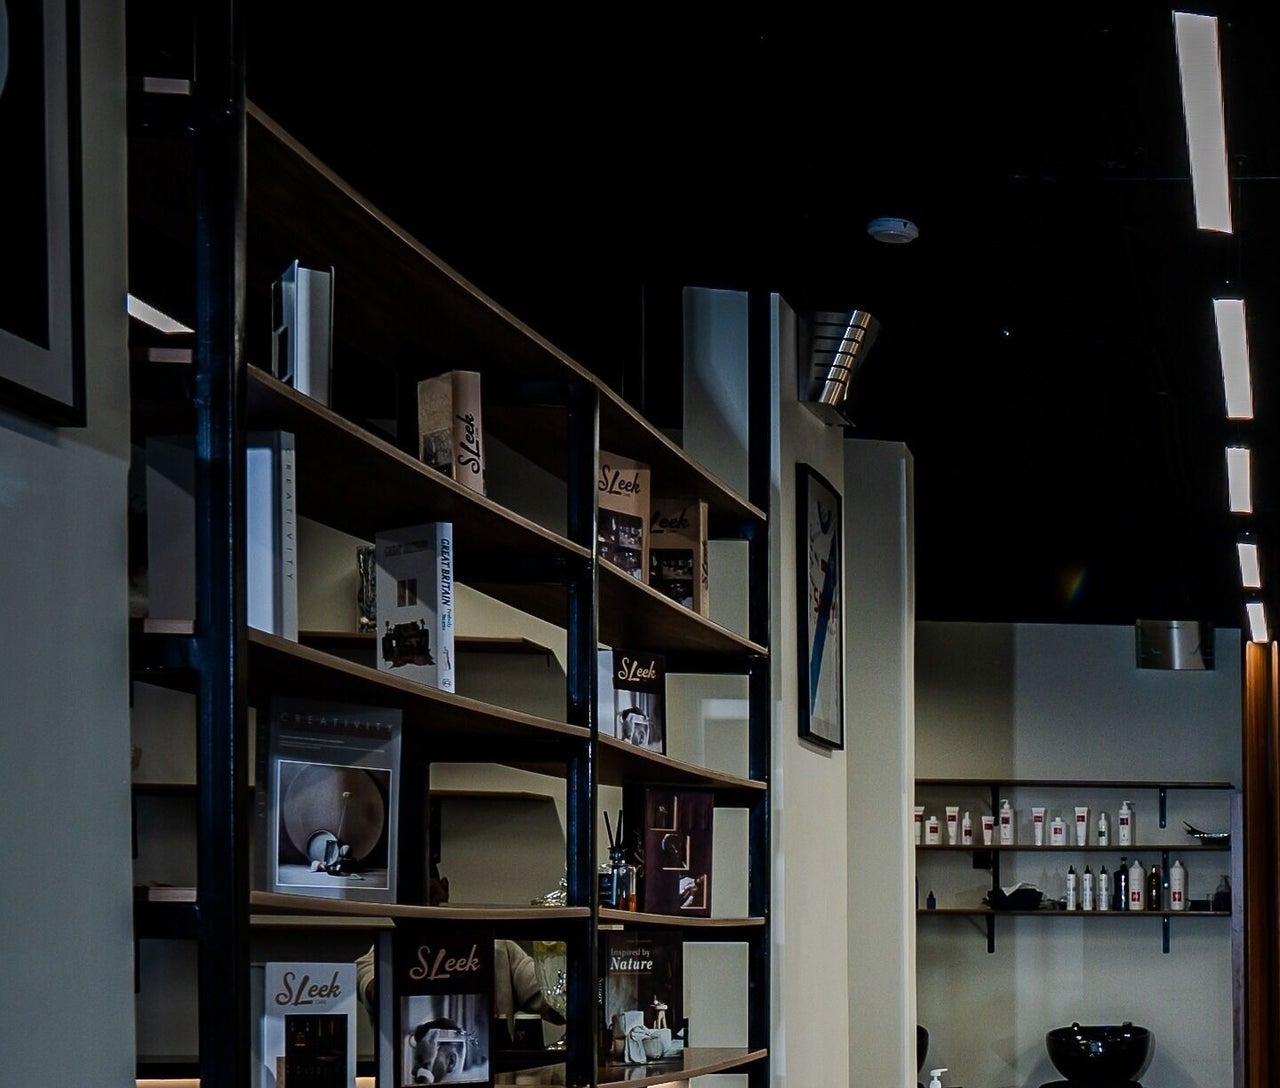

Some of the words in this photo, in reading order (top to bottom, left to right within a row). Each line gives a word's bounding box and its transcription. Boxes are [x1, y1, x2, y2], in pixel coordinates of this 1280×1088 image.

[598, 464, 641, 496] SLeek
[285, 447, 294, 581] CREATIVITY
[650, 508, 689, 534] Leek
[441, 538, 450, 566] GREAT
[441, 568, 451, 606] BRITAIN
[618, 656, 657, 682] SLeek
[280, 711, 393, 731] CREATIVITY
[409, 944, 481, 981] SLeek
[610, 947, 641, 958] Inspired
[642, 947, 651, 958] by
[610, 956, 654, 971] Nature
[275, 971, 342, 1006] SLeek
